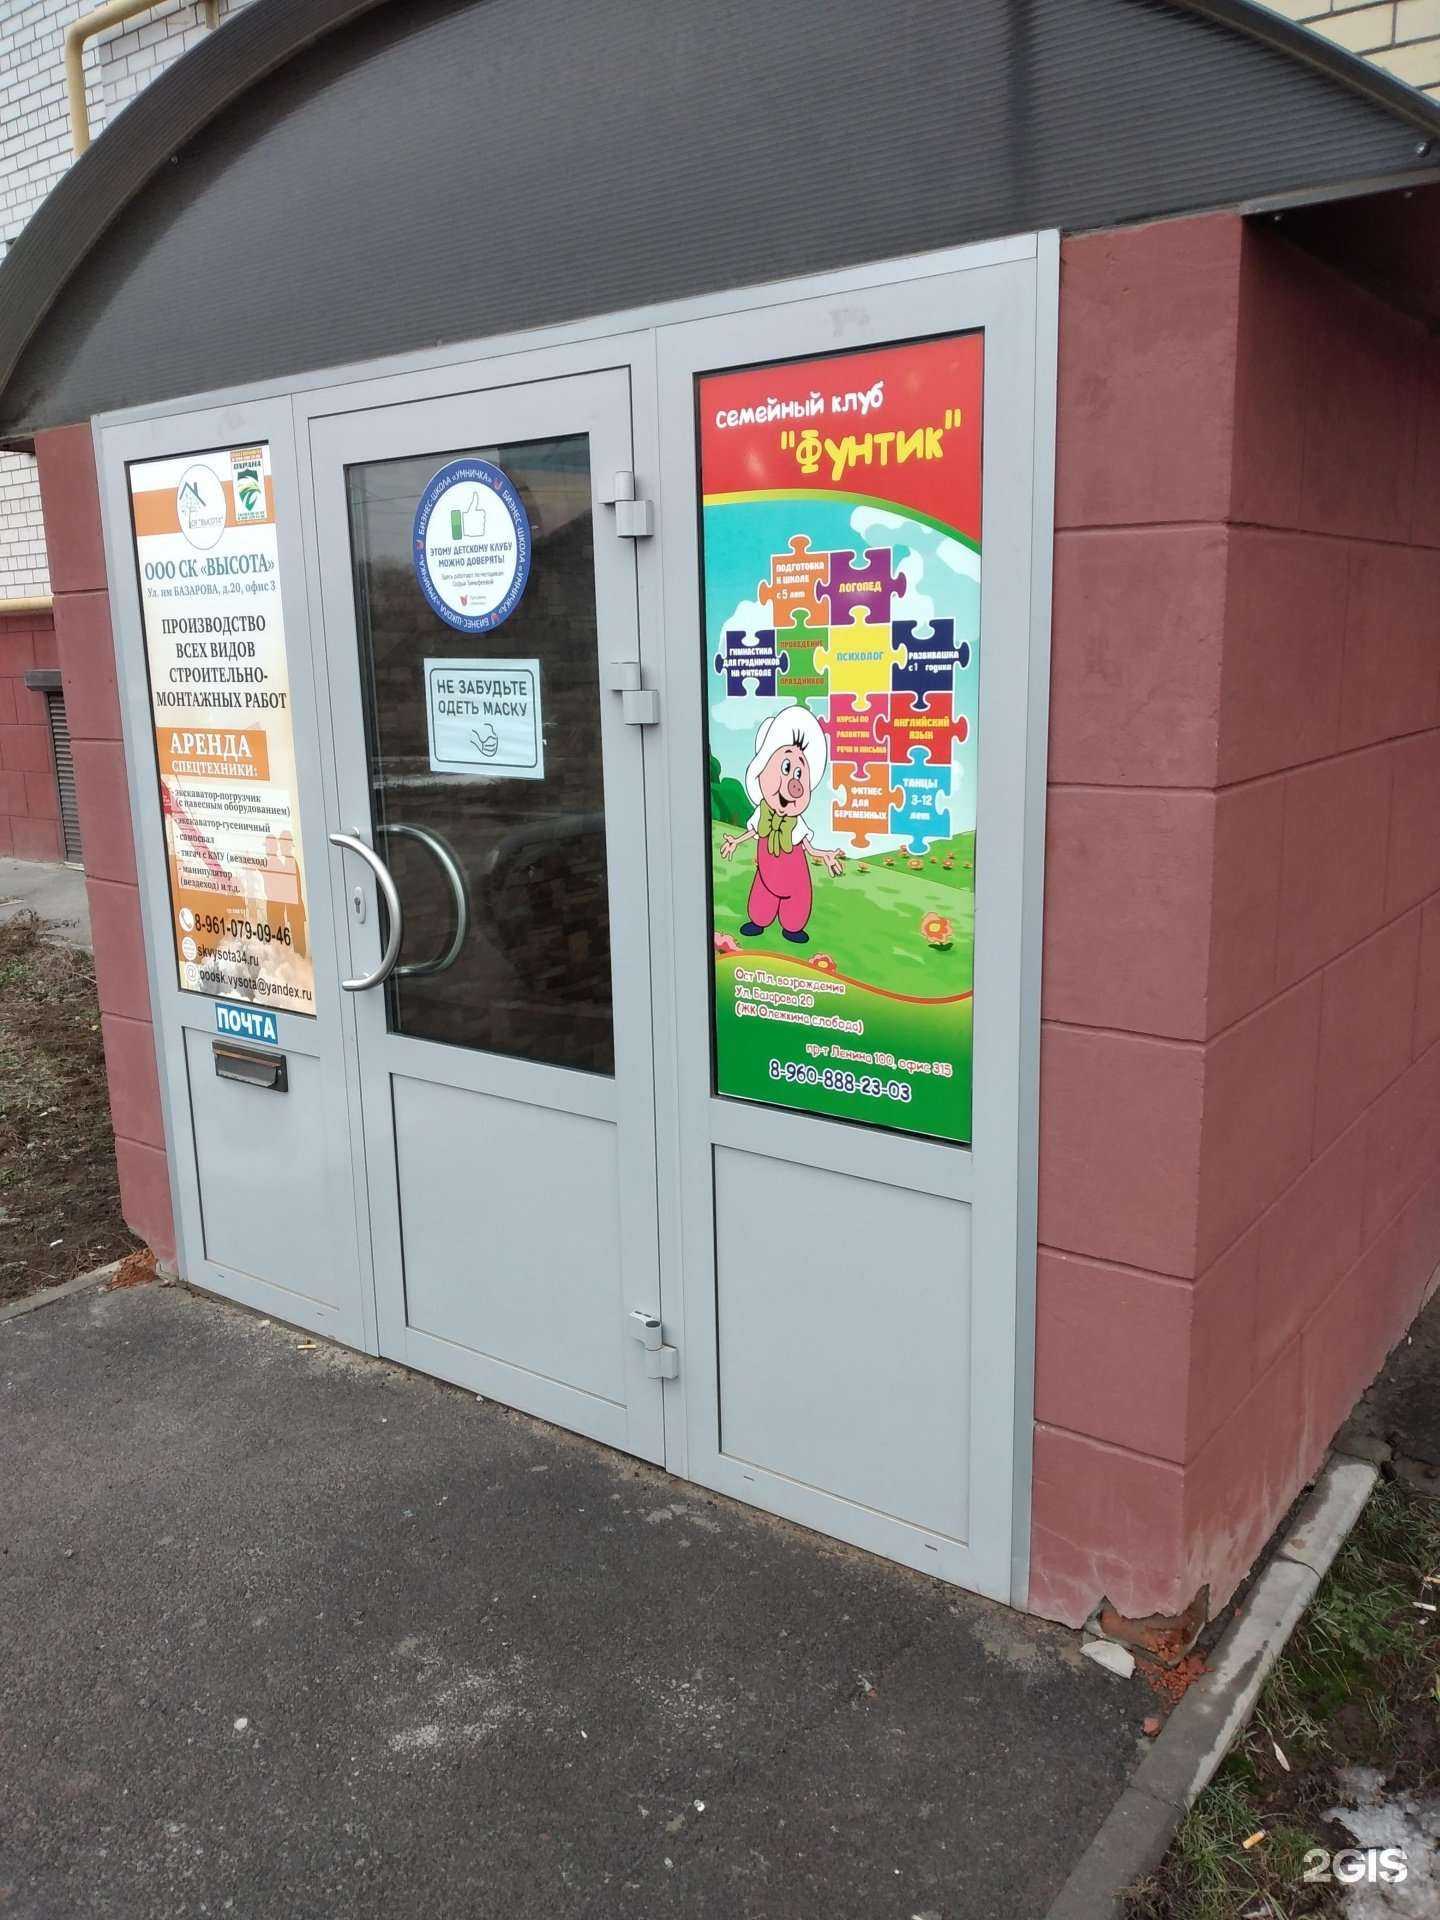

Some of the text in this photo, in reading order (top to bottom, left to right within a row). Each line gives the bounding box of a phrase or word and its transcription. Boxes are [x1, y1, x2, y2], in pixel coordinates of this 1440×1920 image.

[715, 380, 884, 428] семейный клуб
[430, 541, 513, 557] ЭТОМУ ДЕТСКОМУ КЛУБУ
[144, 553, 275, 581] ООО СК «ВЫСОТА»
[438, 558, 465, 568] МОЖНО
[776, 561, 825, 573] ПОДГОТОВКА
[783, 574, 810, 584] ШКОЛЕ
[839, 581, 882, 593] ЛОГОПЕД
[174, 583, 221, 597] БАЗАРОВА,
[245, 581, 270, 595] офис
[270, 580, 276, 592] 3
[162, 615, 266, 636] ПРОИЗВОДСТВО
[176, 642, 256, 661] ВСЕХ ВИДОВ
[729, 648, 773, 656] ГИМНАСТИКА
[837, 651, 884, 661] ПСИХОЛОГ
[723, 658, 780, 667] ДЛЯ ГРУДНИЧКОВ
[169, 667, 268, 683] СТРОИТЕЛЬНО-
[731, 668, 772, 677] НА ФИТБОЛЕ
[437, 679, 528, 698] НЕ ЗАБУДЬТЕ
[156, 691, 287, 709] МОНТАЖНЫХ РАБОТ
[438, 700, 527, 717] ОДЕТЬ МАСКУ
[893, 715, 950, 728] АНГЛИЙСКИЙ
[908, 730, 934, 740] ЯЗЫК
[170, 733, 252, 762] АРЕНДА
[171, 760, 259, 777] СПЕЦТЕХНИКИ:
[851, 787, 883, 795] ФИТНЕС
[902, 778, 938, 789] ТАНЦЫ
[185, 800, 223, 811] навесным
[223, 802, 291, 817] оборудованием)
[851, 798, 869, 808] ДЛЯ
[911, 795, 932, 806] 3-12
[834, 810, 887, 819] БЕРЕМЕННЫХ
[179, 833, 215, 843] самосвал
[226, 852, 268, 868] (вездеход)
[182, 866, 233, 880] манипулятор
[180, 877, 220, 890] (вездеход)
[194, 914, 291, 946] 8-961-079-09-46
[197, 944, 260, 966] skvysota34.ru
[199, 970, 313, 1001] ooosk.vysota@yandex.ru
[753, 988, 798, 1006] Базарова
[799, 994, 814, 1008] 20
[217, 1007, 276, 1040] ПОЧТА
[735, 1001, 757, 1017] (ЖК
[811, 1016, 864, 1035] слобода)
[806, 1044, 952, 1077] пр-т Ленина 100, офис 315
[769, 1059, 912, 1102] 8-960-888-23-03
